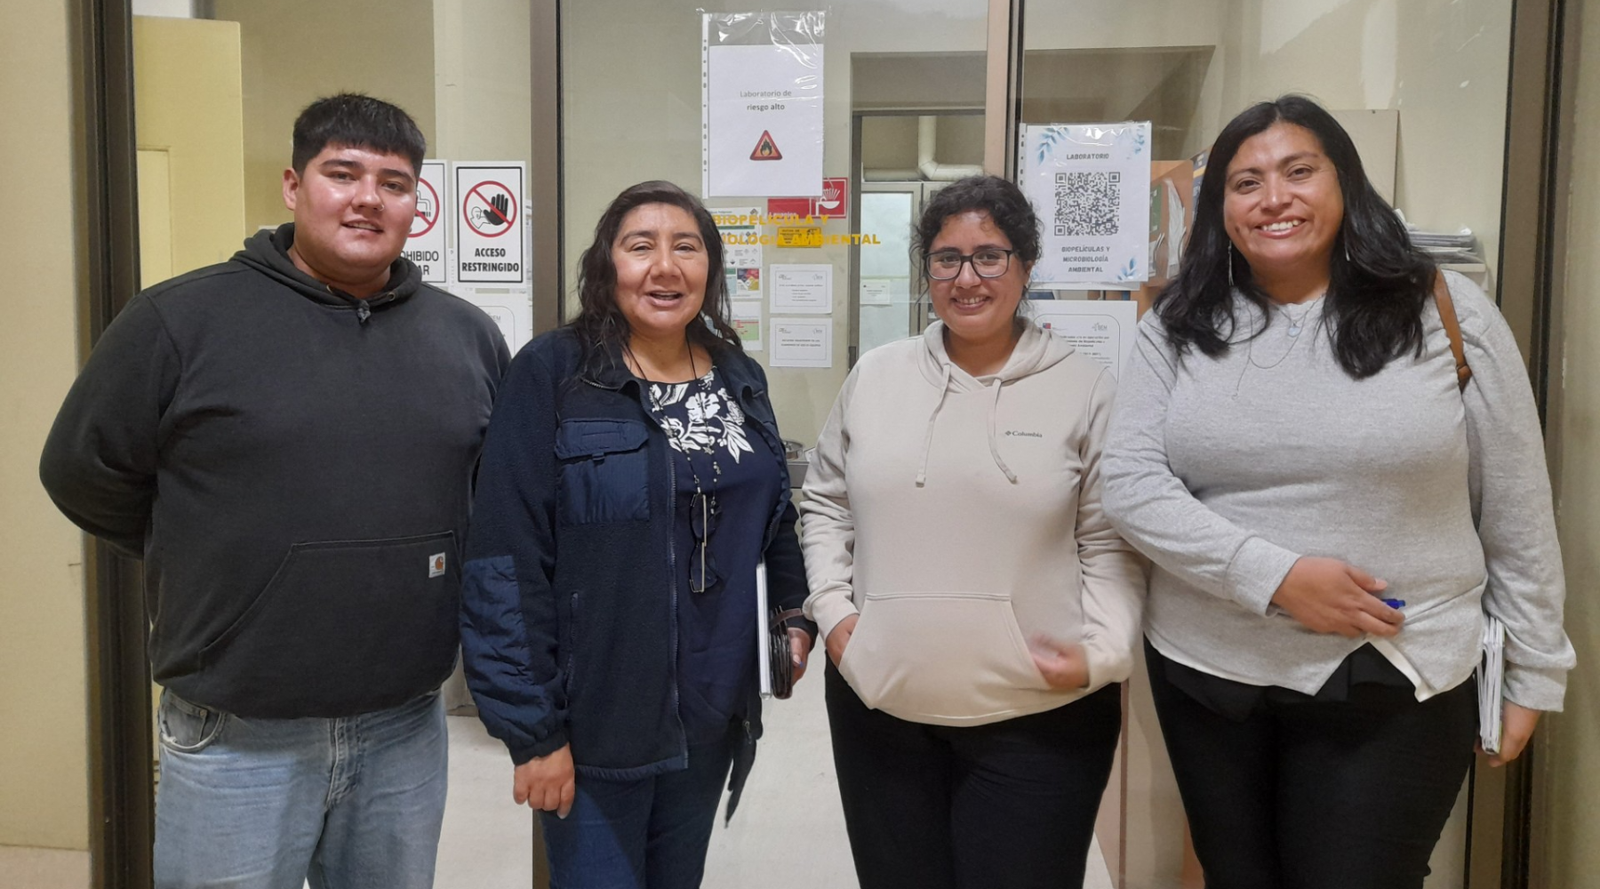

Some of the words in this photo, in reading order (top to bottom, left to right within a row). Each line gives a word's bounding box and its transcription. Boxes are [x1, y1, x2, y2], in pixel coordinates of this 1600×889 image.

[740, 90, 782, 98] Laboratorio
[782, 89, 792, 97] de
[746, 104, 769, 112] riesgo
[819, 214, 830, 225] Y
[399, 250, 439, 262] OHIBIDO
[474, 248, 506, 258] ACCESO
[1062, 254, 1109, 262] MICROBIOLOGÍA
[461, 262, 520, 272] RESTRINGIDO
[1011, 430, 1043, 438] Columbia
